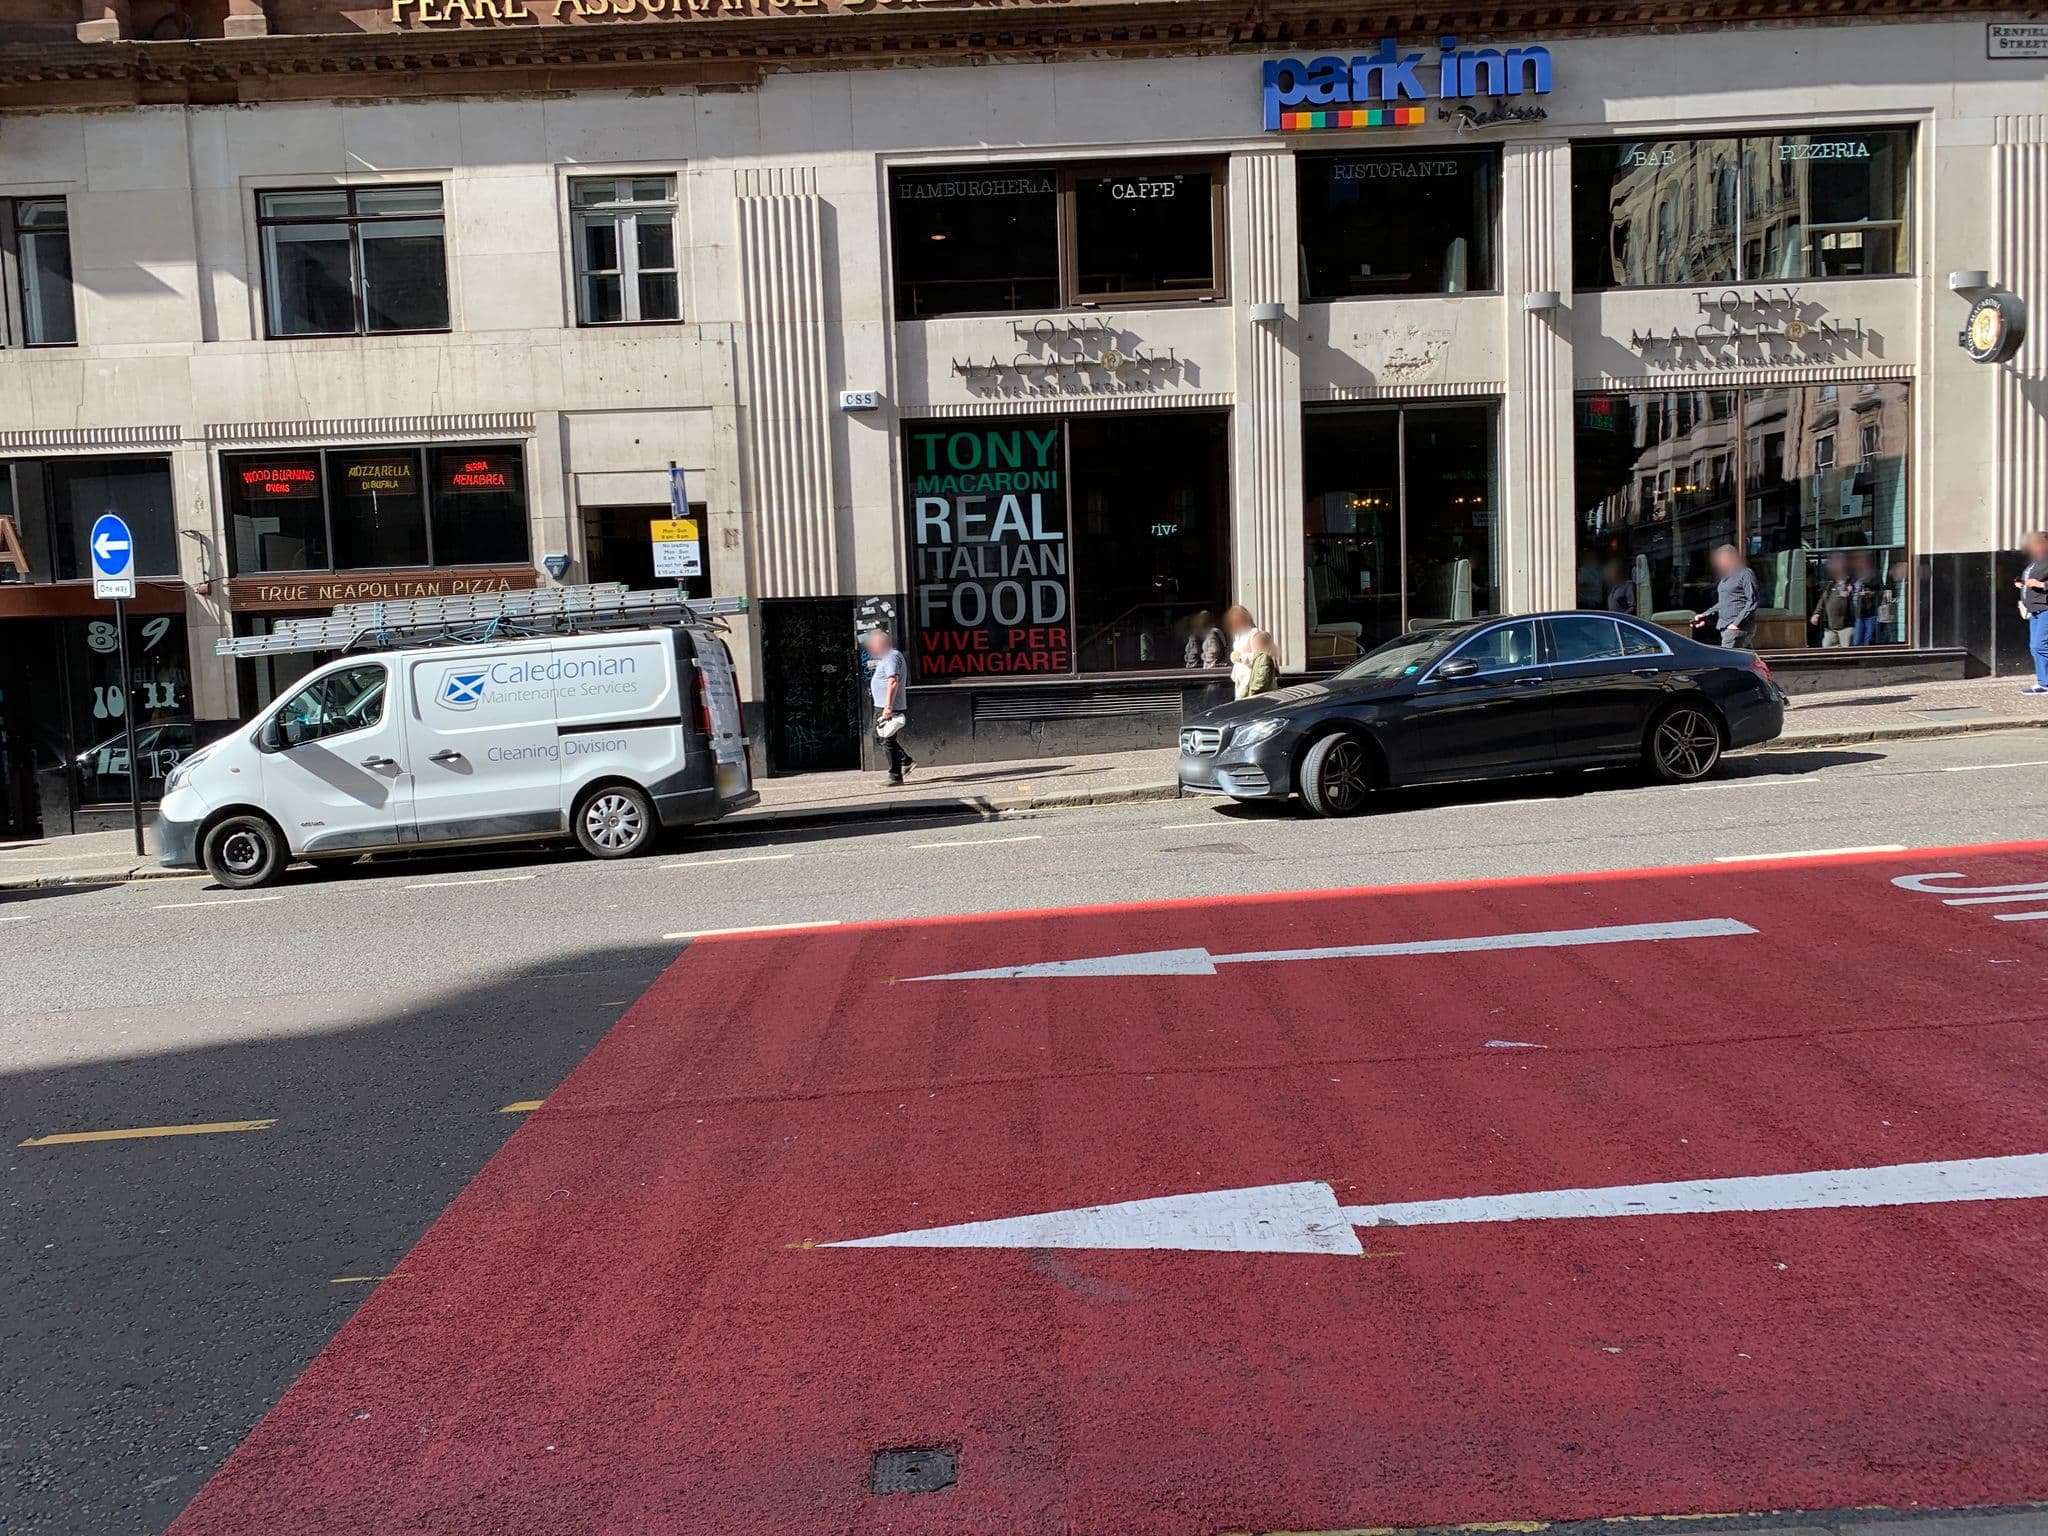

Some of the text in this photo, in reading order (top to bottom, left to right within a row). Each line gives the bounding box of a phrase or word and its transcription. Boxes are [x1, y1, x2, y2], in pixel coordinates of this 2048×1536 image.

[1999, 38, 2048, 48] STREET
[1263, 36, 1552, 131] park inn
[1438, 108, 1453, 122] by
[1634, 151, 1677, 166] BAR
[1778, 142, 1870, 161] PIZZERIA
[1333, 161, 1458, 179] RISTORANTE
[900, 178, 1053, 199] HAMBURGHERIA
[1692, 287, 1800, 314] TONY
[1006, 316, 1113, 342] TONY
[912, 429, 1058, 471] TONY
[243, 469, 315, 484] WOOD BURNING
[348, 465, 410, 478] MOZZARELLA
[916, 470, 1058, 494] MACARONI
[265, 483, 290, 493] OVENS
[915, 493, 1064, 544] REAL
[917, 543, 1066, 580] ITALIAN
[100, 584, 128, 594] One way
[257, 577, 512, 600] TRUE NEAPOLITAN PIZZA
[919, 580, 1066, 628] FOOD
[87, 617, 170, 653] 8 9
[922, 628, 1068, 652] VIVE PER
[491, 655, 636, 684] Caledonian
[922, 651, 1068, 674] MANGIARE
[93, 682, 179, 719] 10 11
[482, 681, 638, 704] Maintenance Services
[487, 738, 627, 762] Cleaning Division
